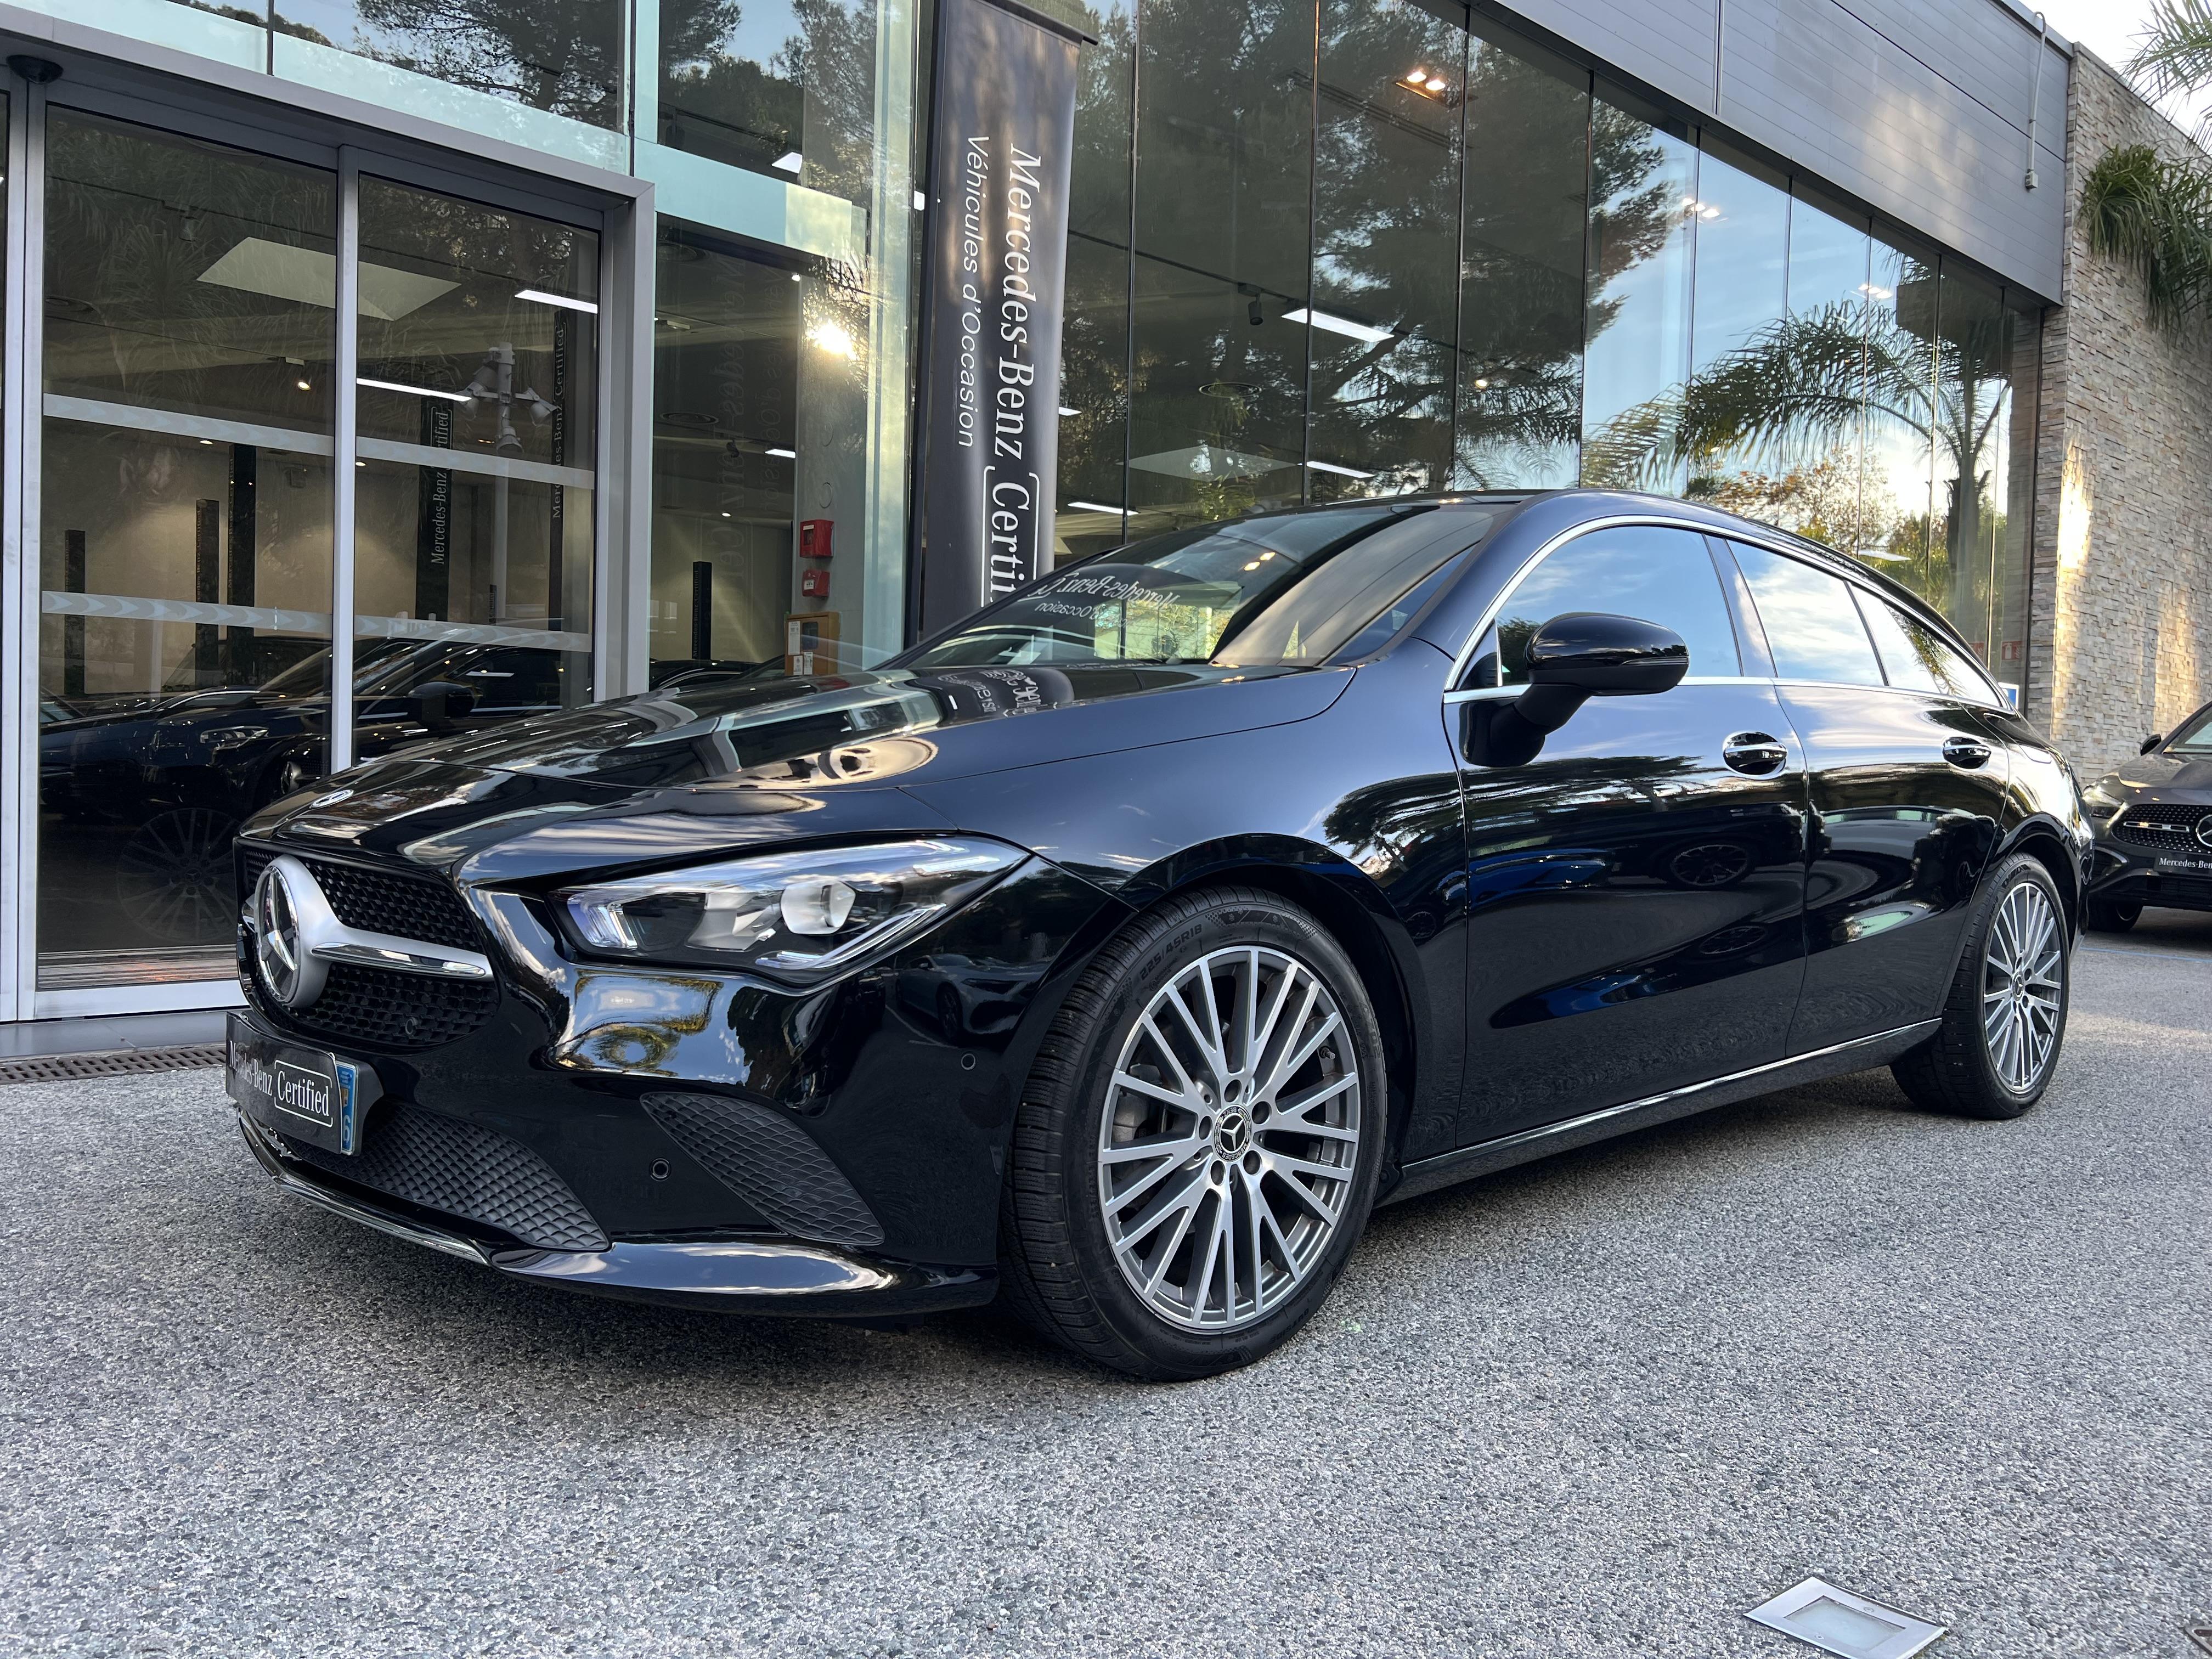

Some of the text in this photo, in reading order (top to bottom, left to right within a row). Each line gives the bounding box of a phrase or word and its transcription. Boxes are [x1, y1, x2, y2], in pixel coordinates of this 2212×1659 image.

[957, 136, 990, 448] Véhicules d'Occasion
[994, 143, 1042, 461] Mercedes-Benz
[555, 329, 565, 396] Certified
[431, 411, 449, 566] Mercedes-Benz rtified
[2158, 857, 2212, 870] Mercedes-Ben
[1139, 923, 1203, 981] 225/45R18
[277, 1070, 330, 1117] Certified
[1221, 1143, 1248, 1160] MERCEDES
